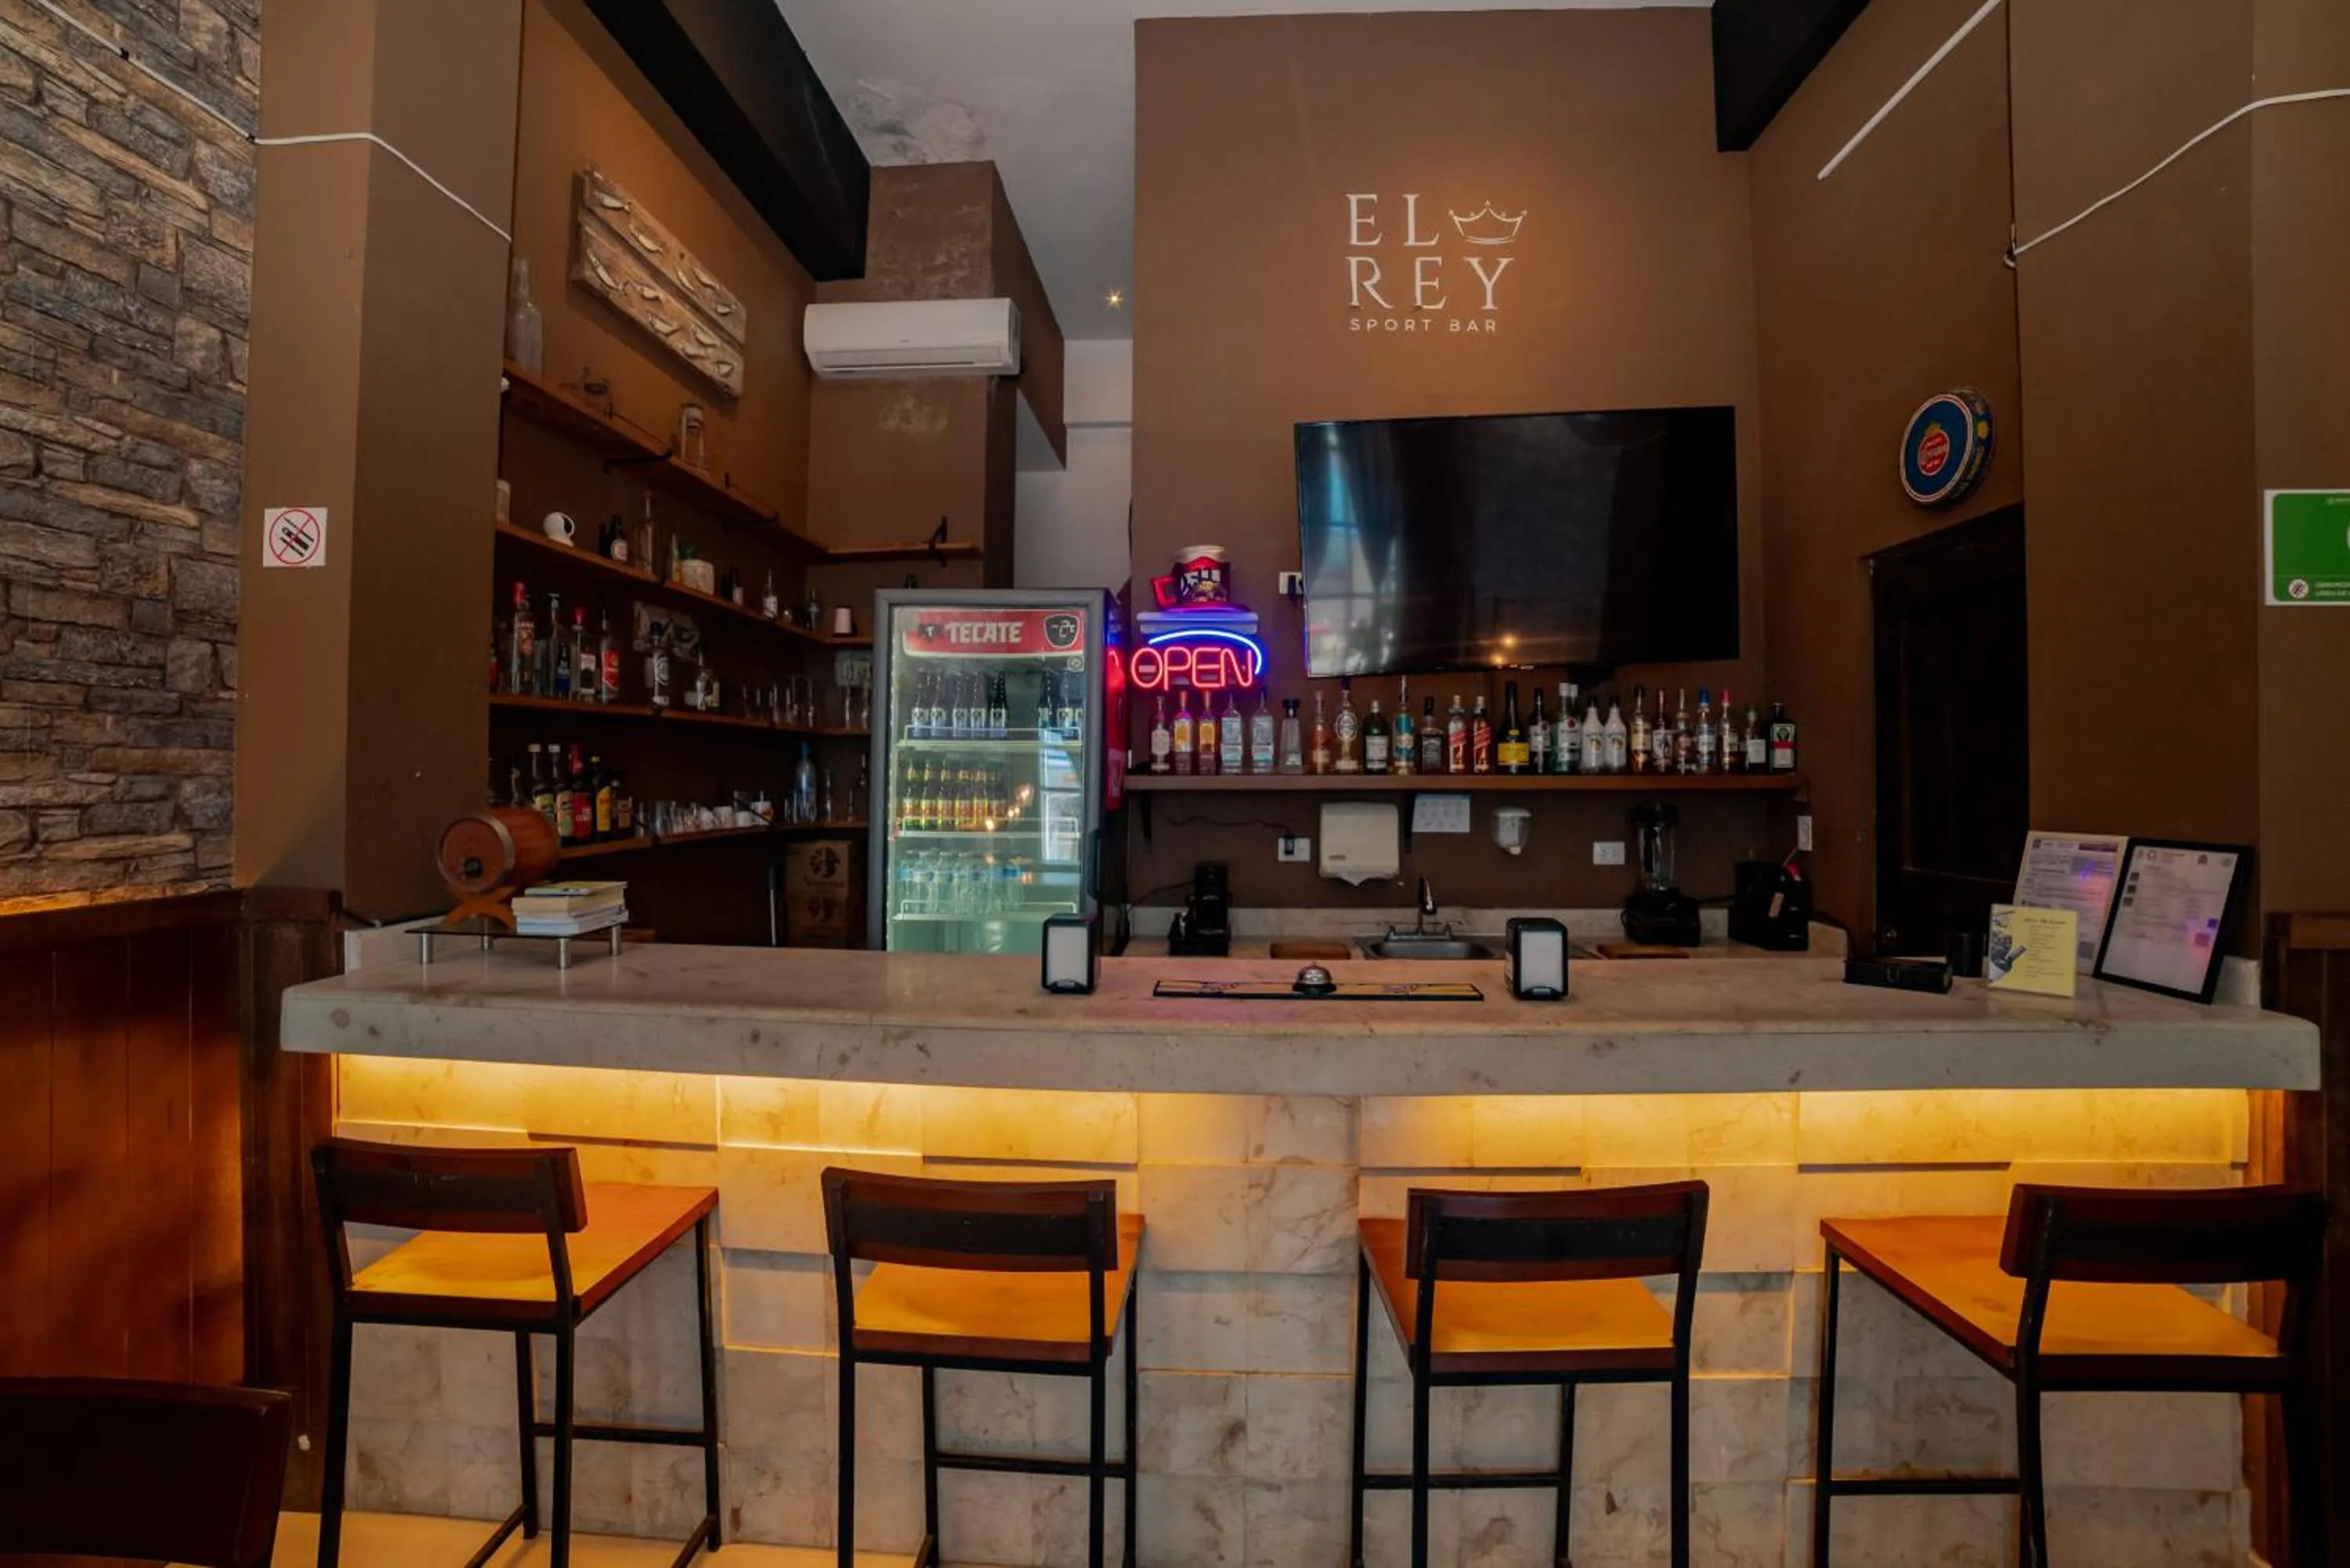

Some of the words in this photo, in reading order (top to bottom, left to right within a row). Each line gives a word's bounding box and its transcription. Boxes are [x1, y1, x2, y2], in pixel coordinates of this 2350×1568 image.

[1345, 193, 1440, 246] EL
[1345, 256, 1515, 309] REY
[1349, 319, 1433, 331] SPORT
[1449, 319, 1497, 332] BAR
[945, 622, 1023, 643] TECATE
[1130, 646, 1253, 692] OPEN
